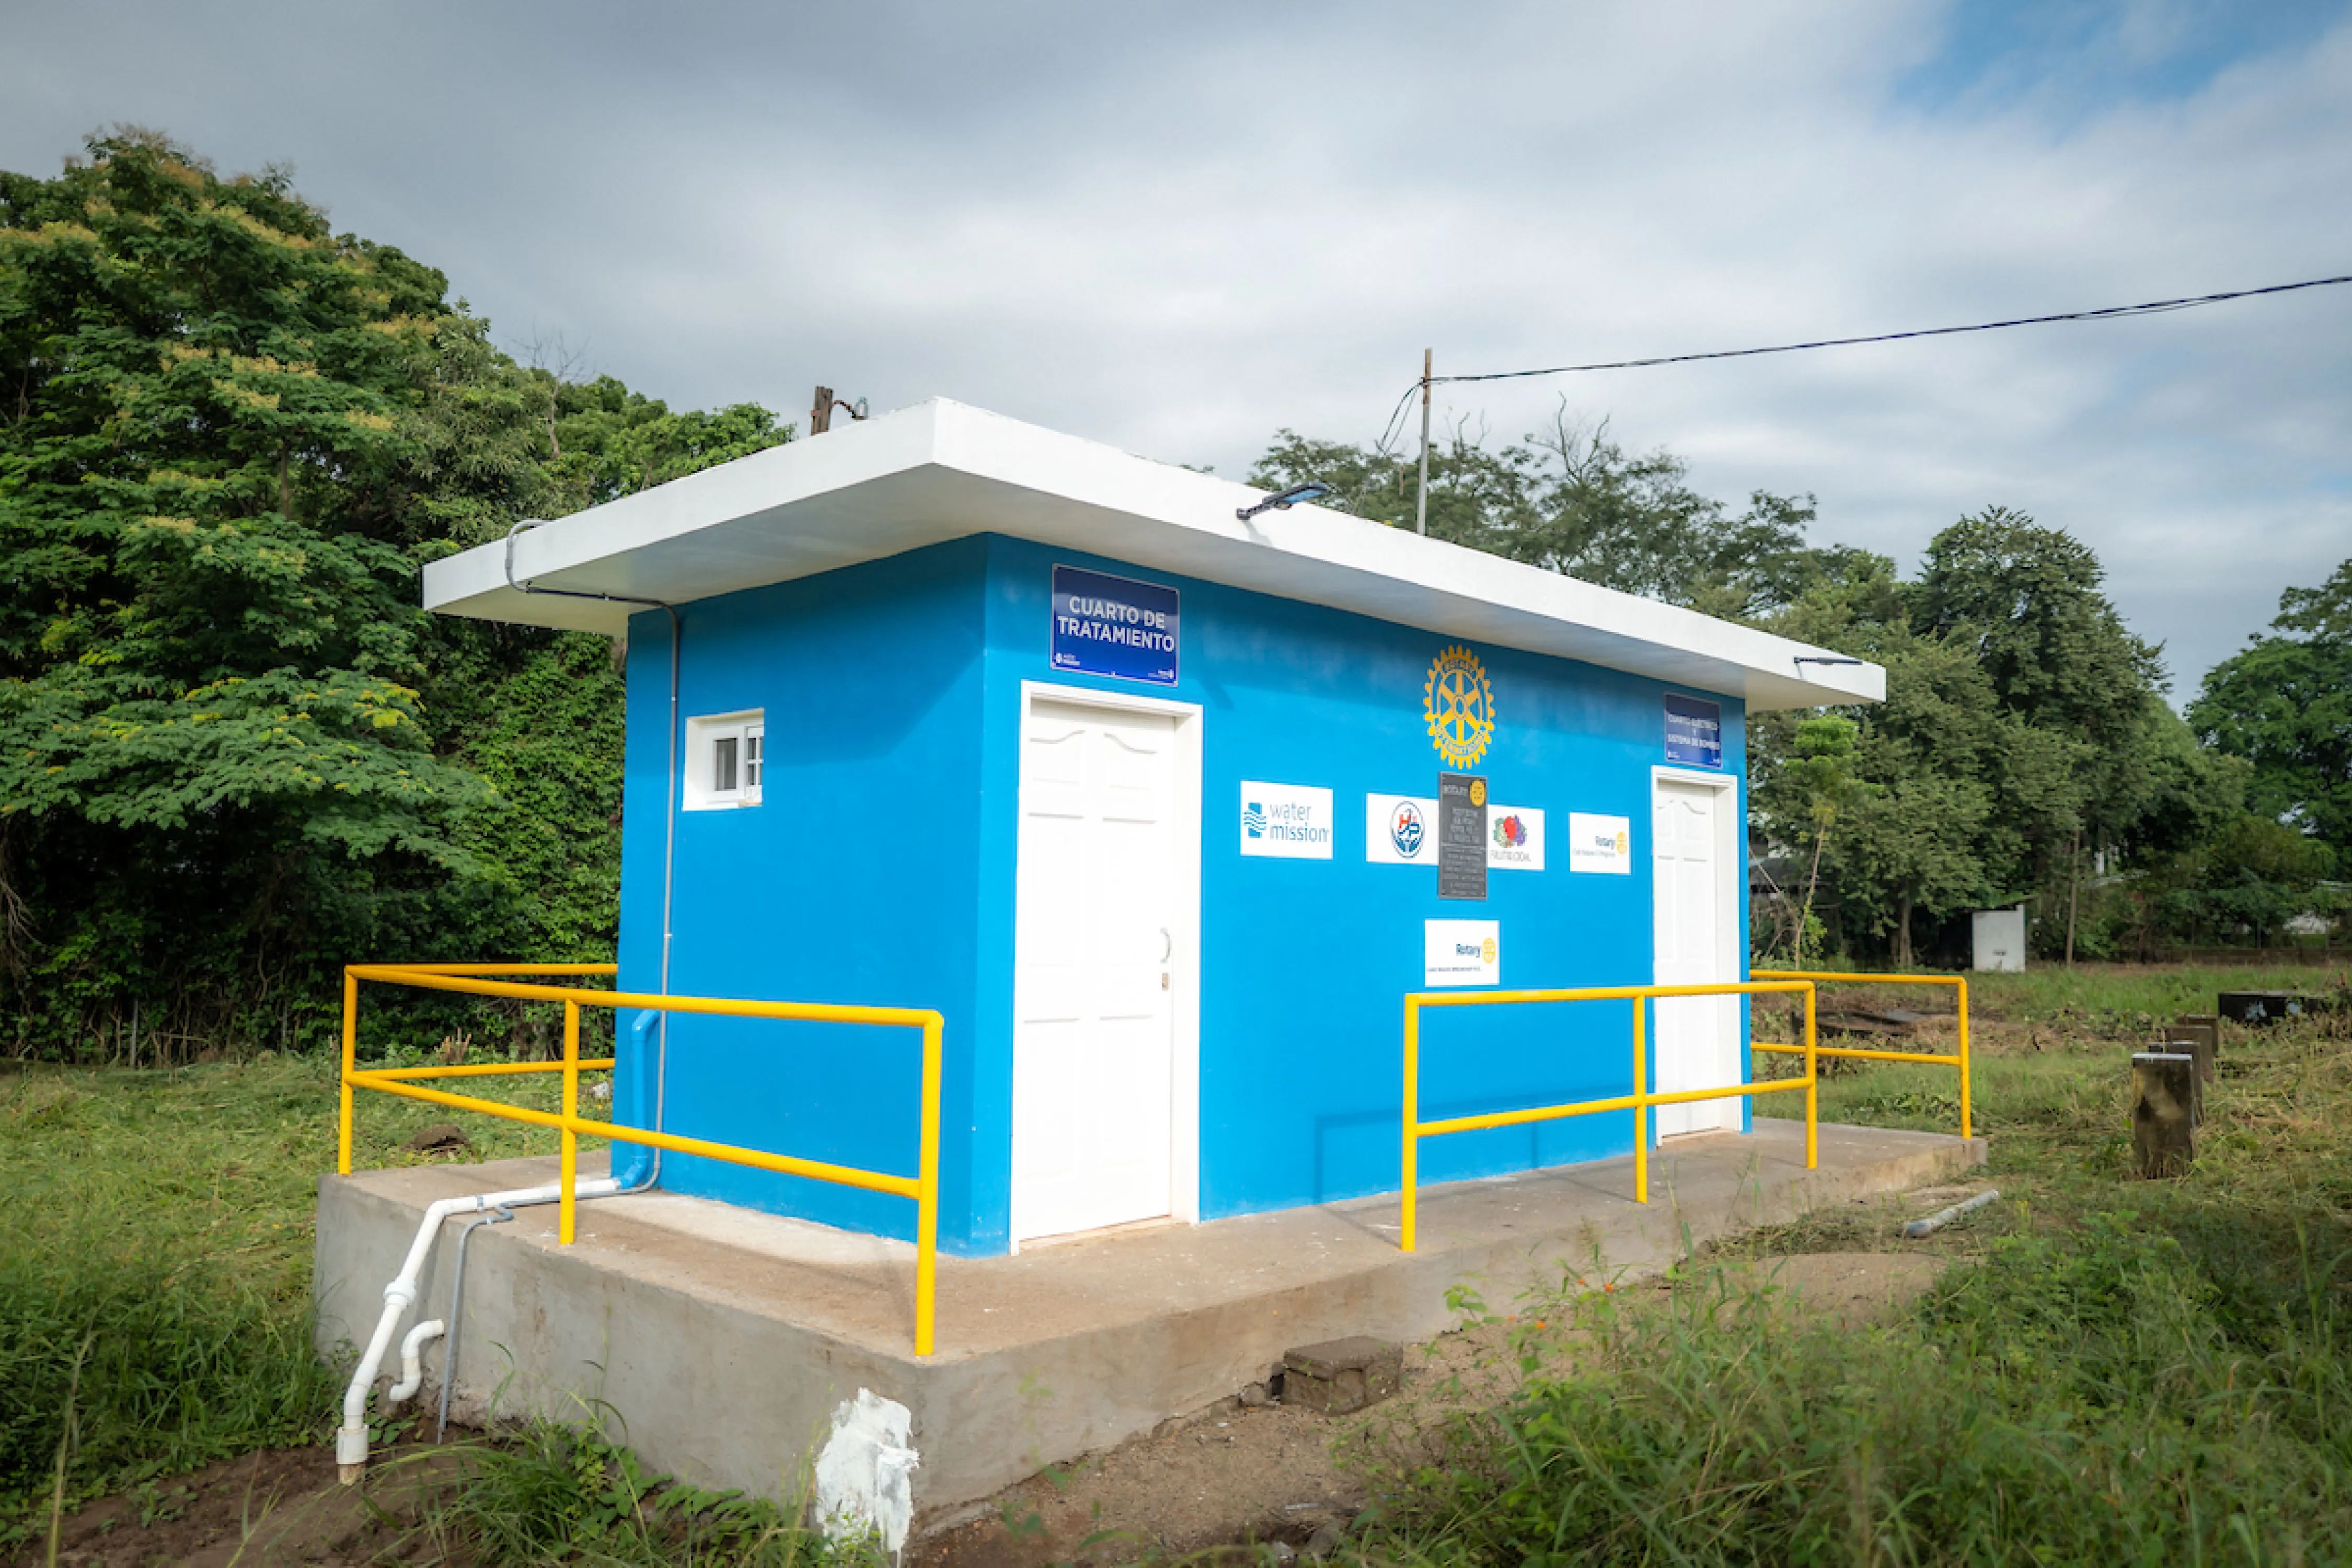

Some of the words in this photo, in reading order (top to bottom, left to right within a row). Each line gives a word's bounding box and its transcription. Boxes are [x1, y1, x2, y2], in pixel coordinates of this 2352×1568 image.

[1069, 596, 1139, 625] CUARTO
[1144, 609, 1166, 629] DE
[1057, 616, 1174, 652] TRATAMIENTO
[1269, 802, 1311, 821] water
[1270, 822, 1330, 843] mission
[1456, 943, 1481, 959] Rotary
